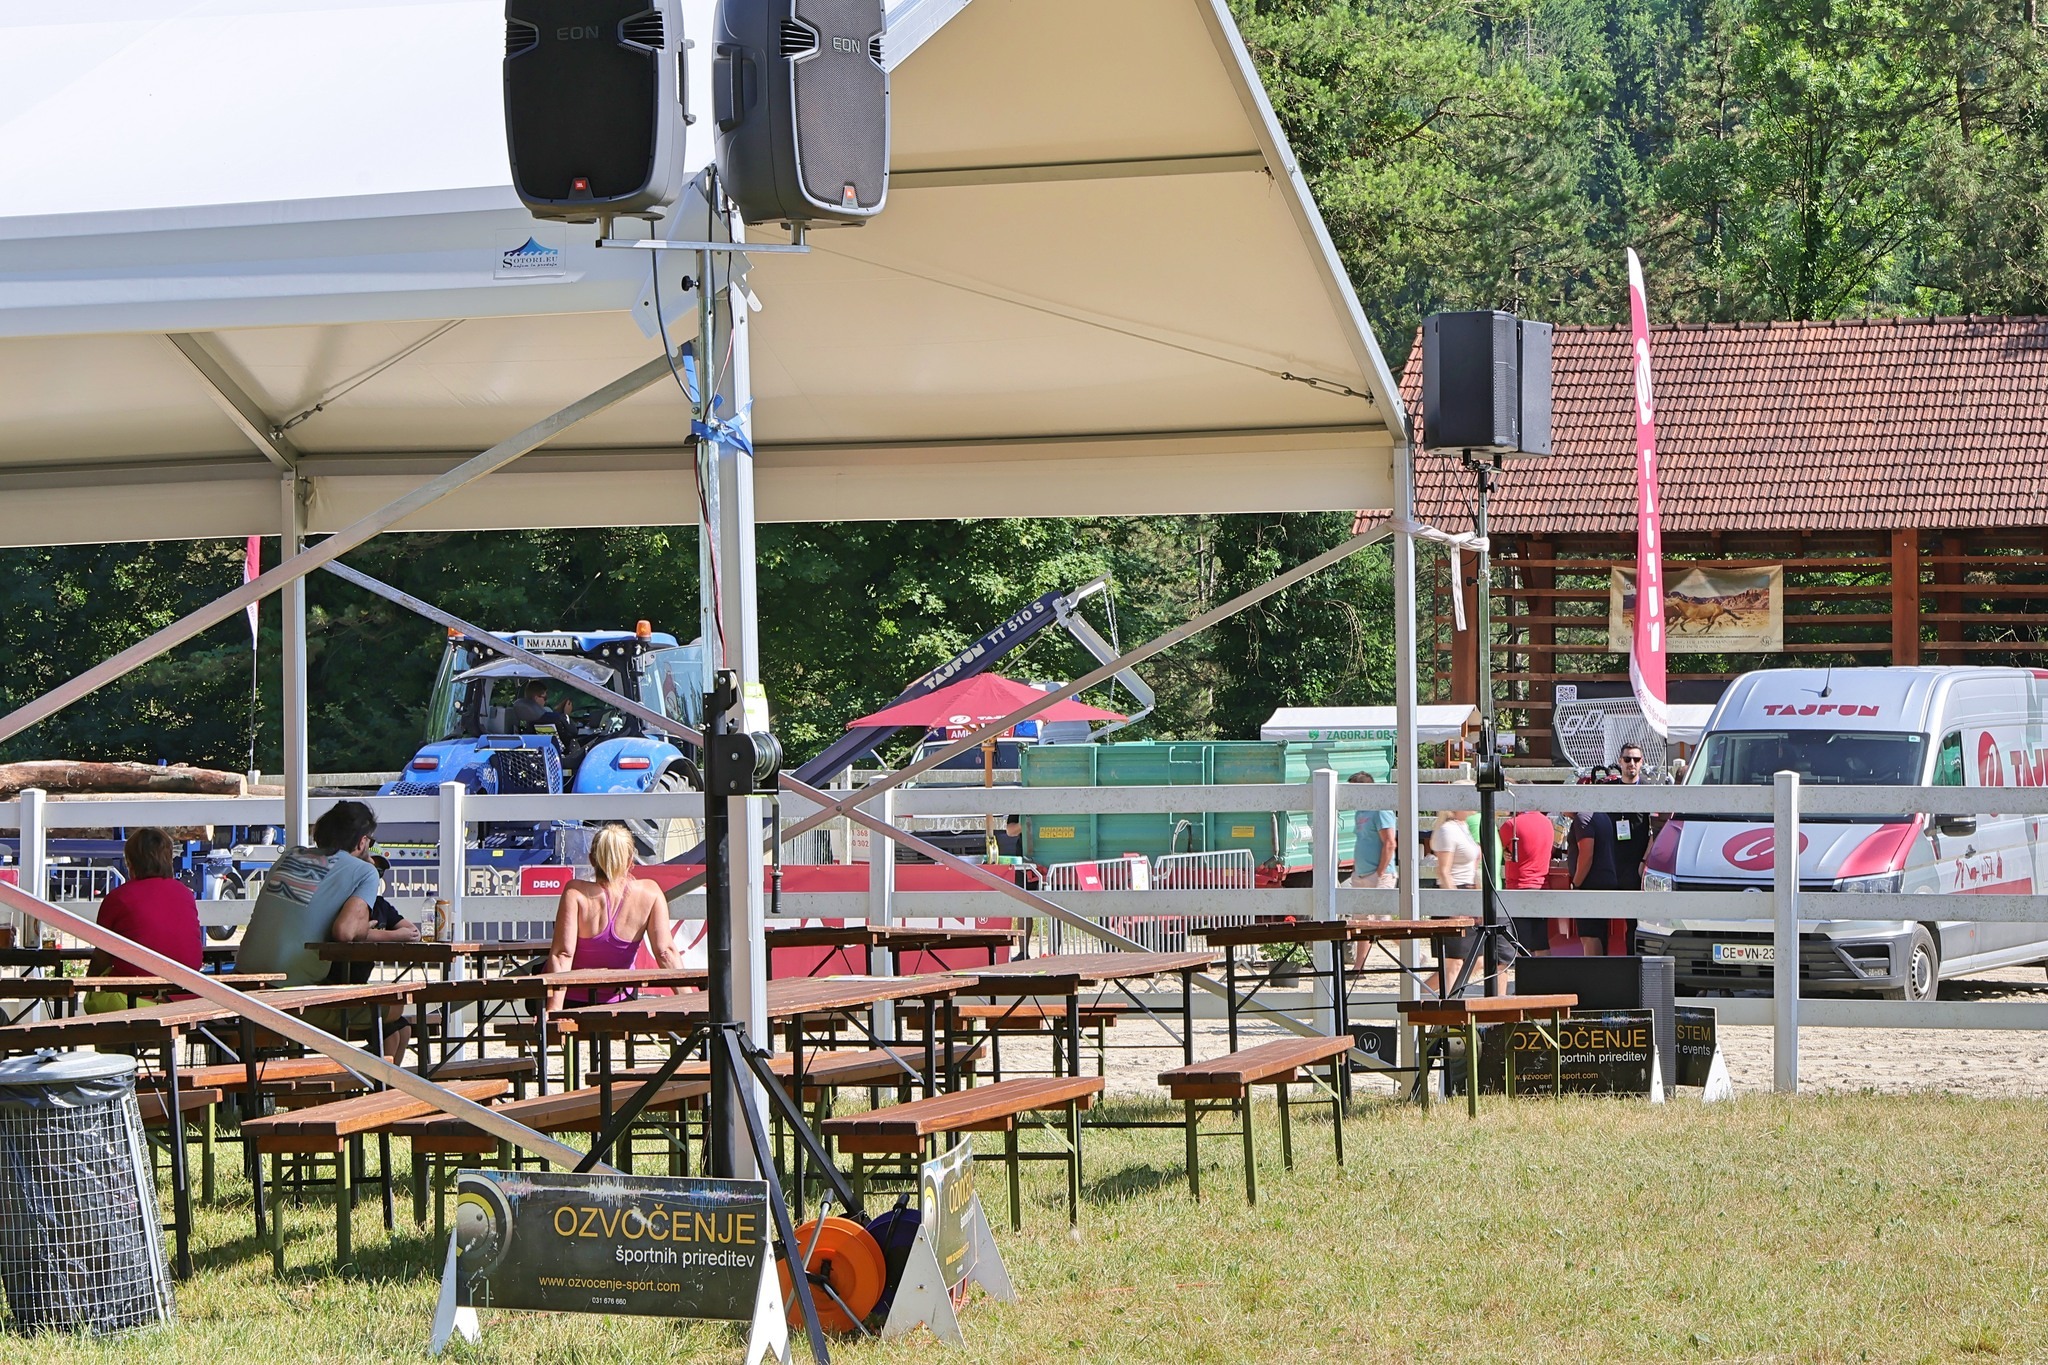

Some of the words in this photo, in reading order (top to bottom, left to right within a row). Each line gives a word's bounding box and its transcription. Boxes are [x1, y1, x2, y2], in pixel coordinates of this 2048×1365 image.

[556, 26, 599, 40] EON
[832, 37, 861, 53] EON
[526, 638, 540, 648] NM
[545, 638, 568, 648] AAAA
[923, 643, 985, 690] TAJFUN
[988, 627, 1006, 645] TT
[1007, 610, 1033, 632] 510
[1032, 601, 1045, 614] S
[1763, 704, 1880, 717] TAJFUN
[1327, 730, 1374, 740] ZAGORJE
[391, 882, 438, 892] TAJFUN
[533, 880, 560, 888] DEMO
[1722, 947, 1736, 959] CE
[1745, 947, 1774, 960] VN-23
[1675, 1024, 1711, 1041] STEM
[1560, 1052, 1596, 1063] portnih
[1599, 1051, 1647, 1064] prireditev
[554, 1203, 756, 1245] OZVOČENJE
[615, 1245, 677, 1265] športnih
[682, 1248, 756, 1268] prireditev
[539, 1276, 681, 1293] www.ozvocenje-sport.com
